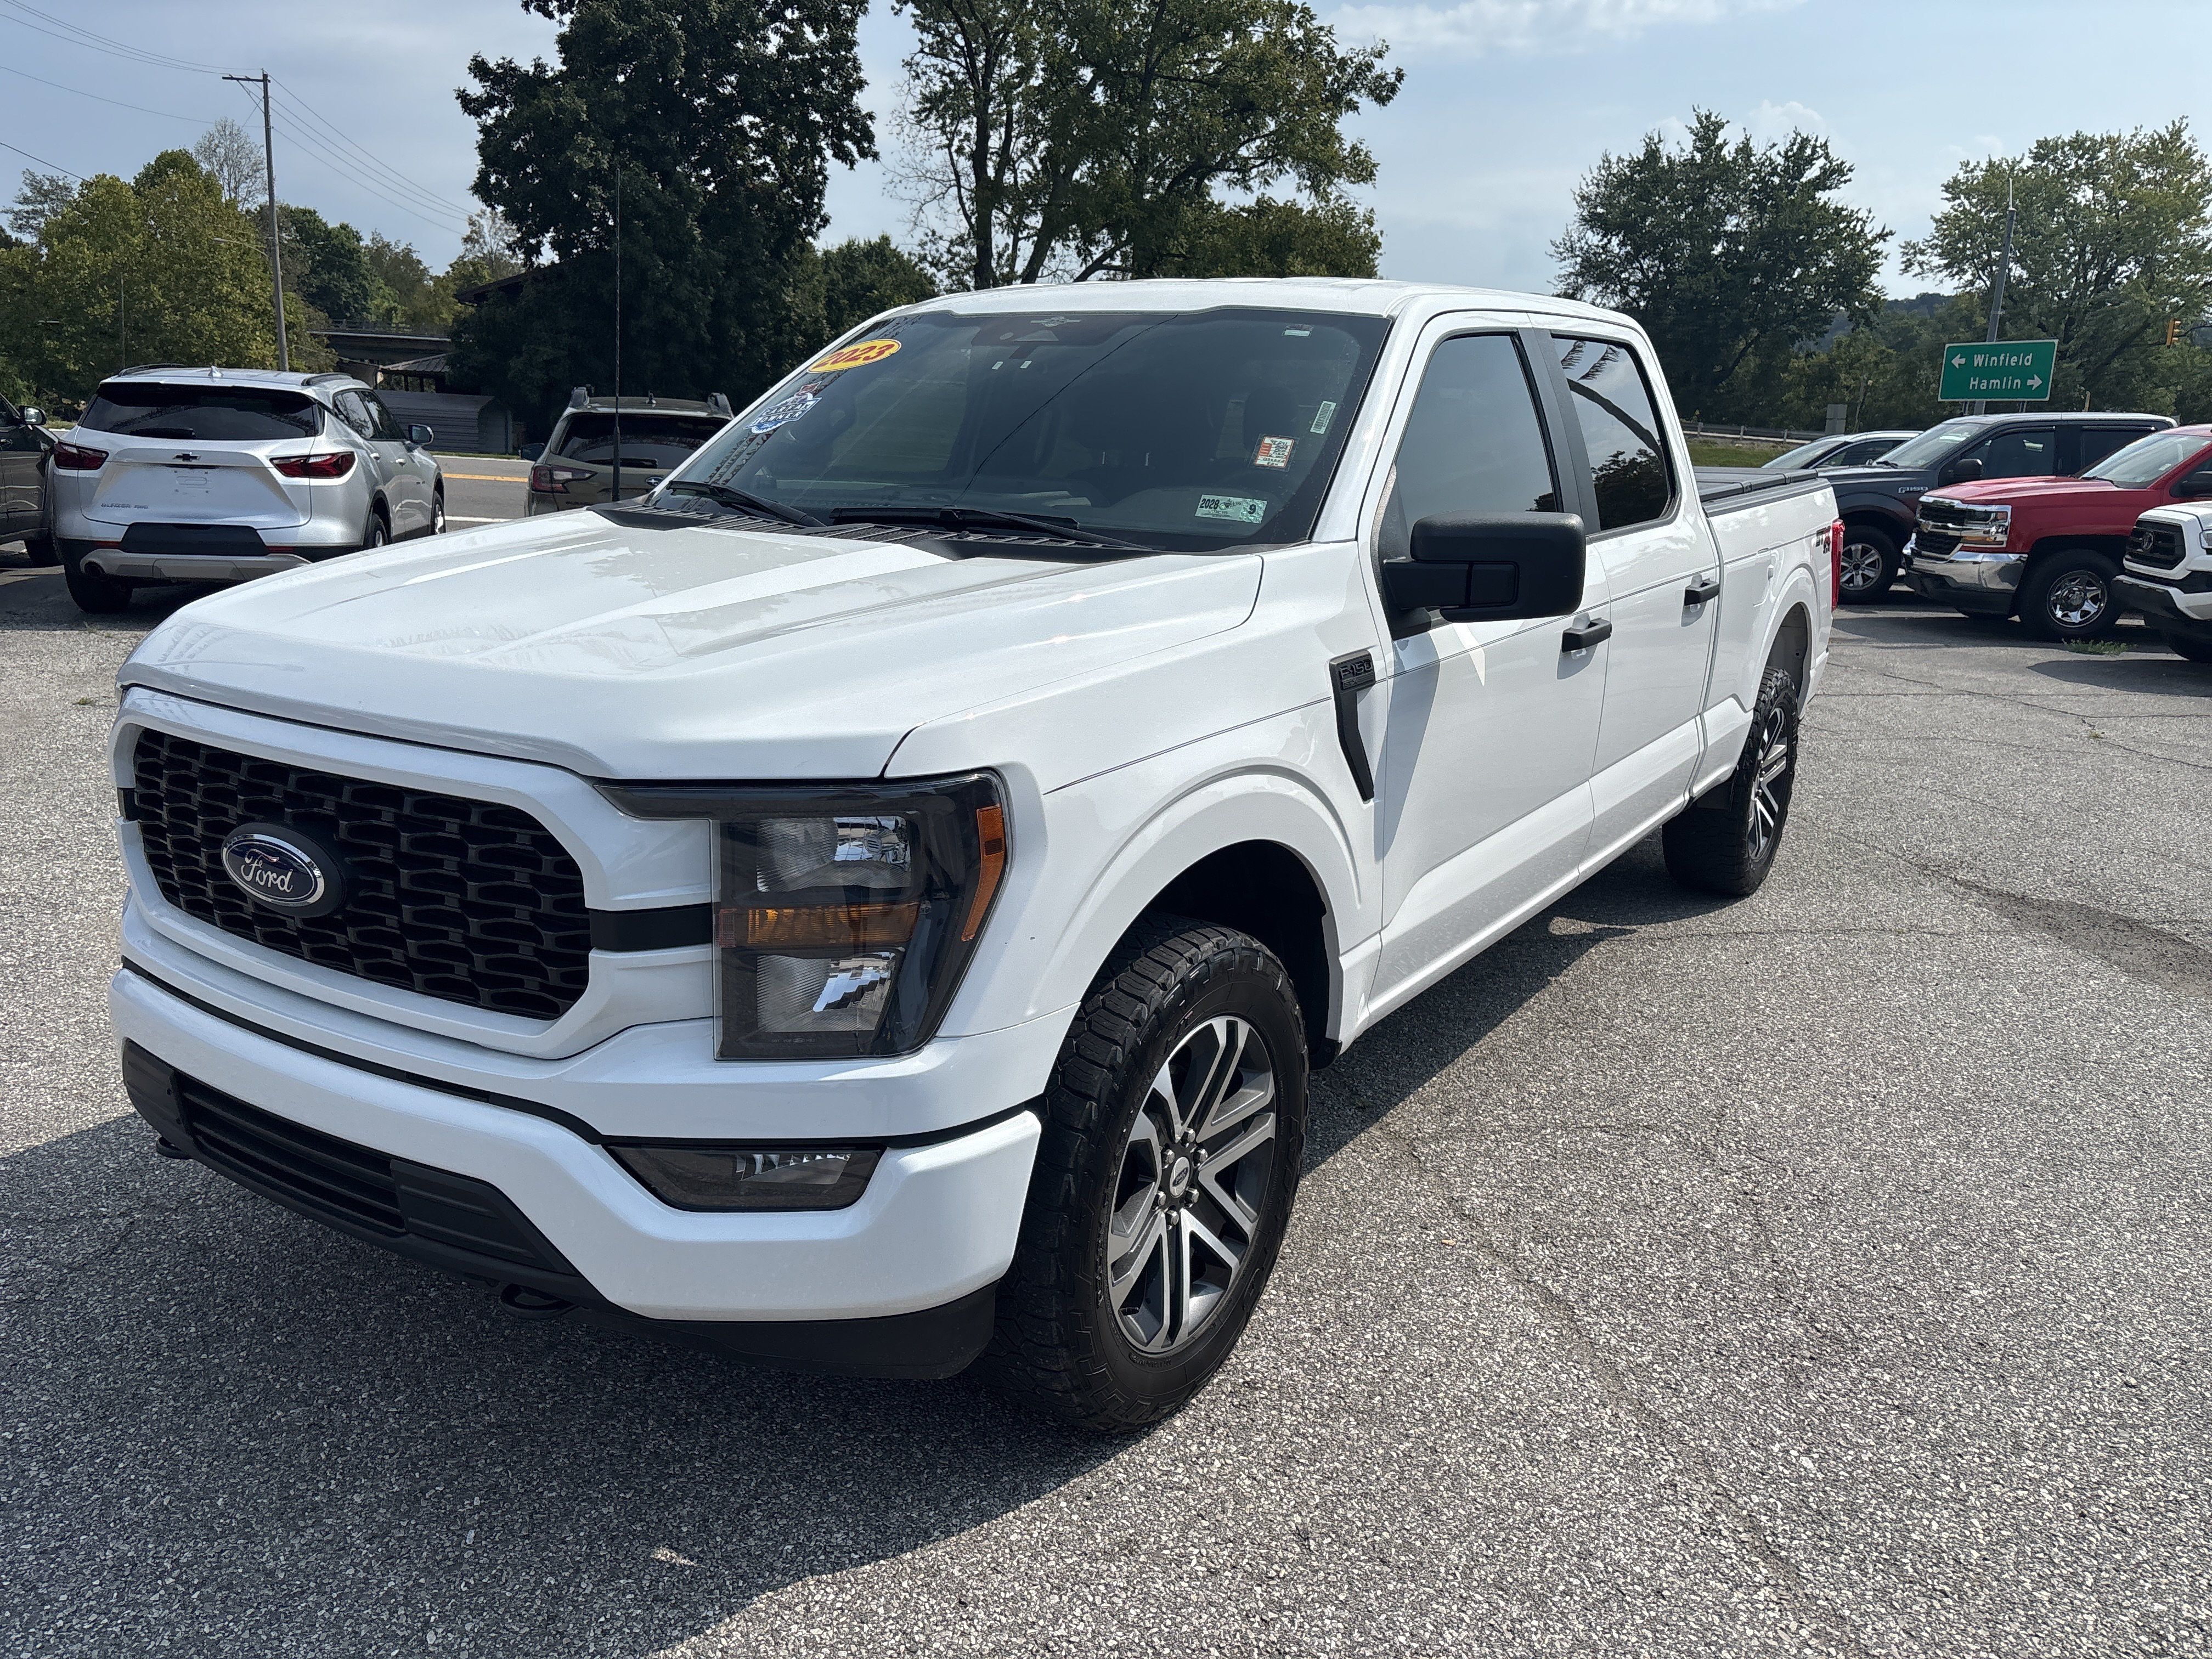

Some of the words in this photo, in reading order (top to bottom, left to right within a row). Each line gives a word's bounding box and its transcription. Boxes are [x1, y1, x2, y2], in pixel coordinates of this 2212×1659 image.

[812, 343, 895, 370] 2023
[1973, 352, 2033, 367] Winfield
[1970, 376, 2021, 390] Hamlin
[761, 400, 815, 416] CARFAX
[759, 411, 803, 423] OWNER
[1199, 498, 1220, 510] 2028
[1248, 504, 1256, 515] 9
[240, 848, 294, 893] Ford
